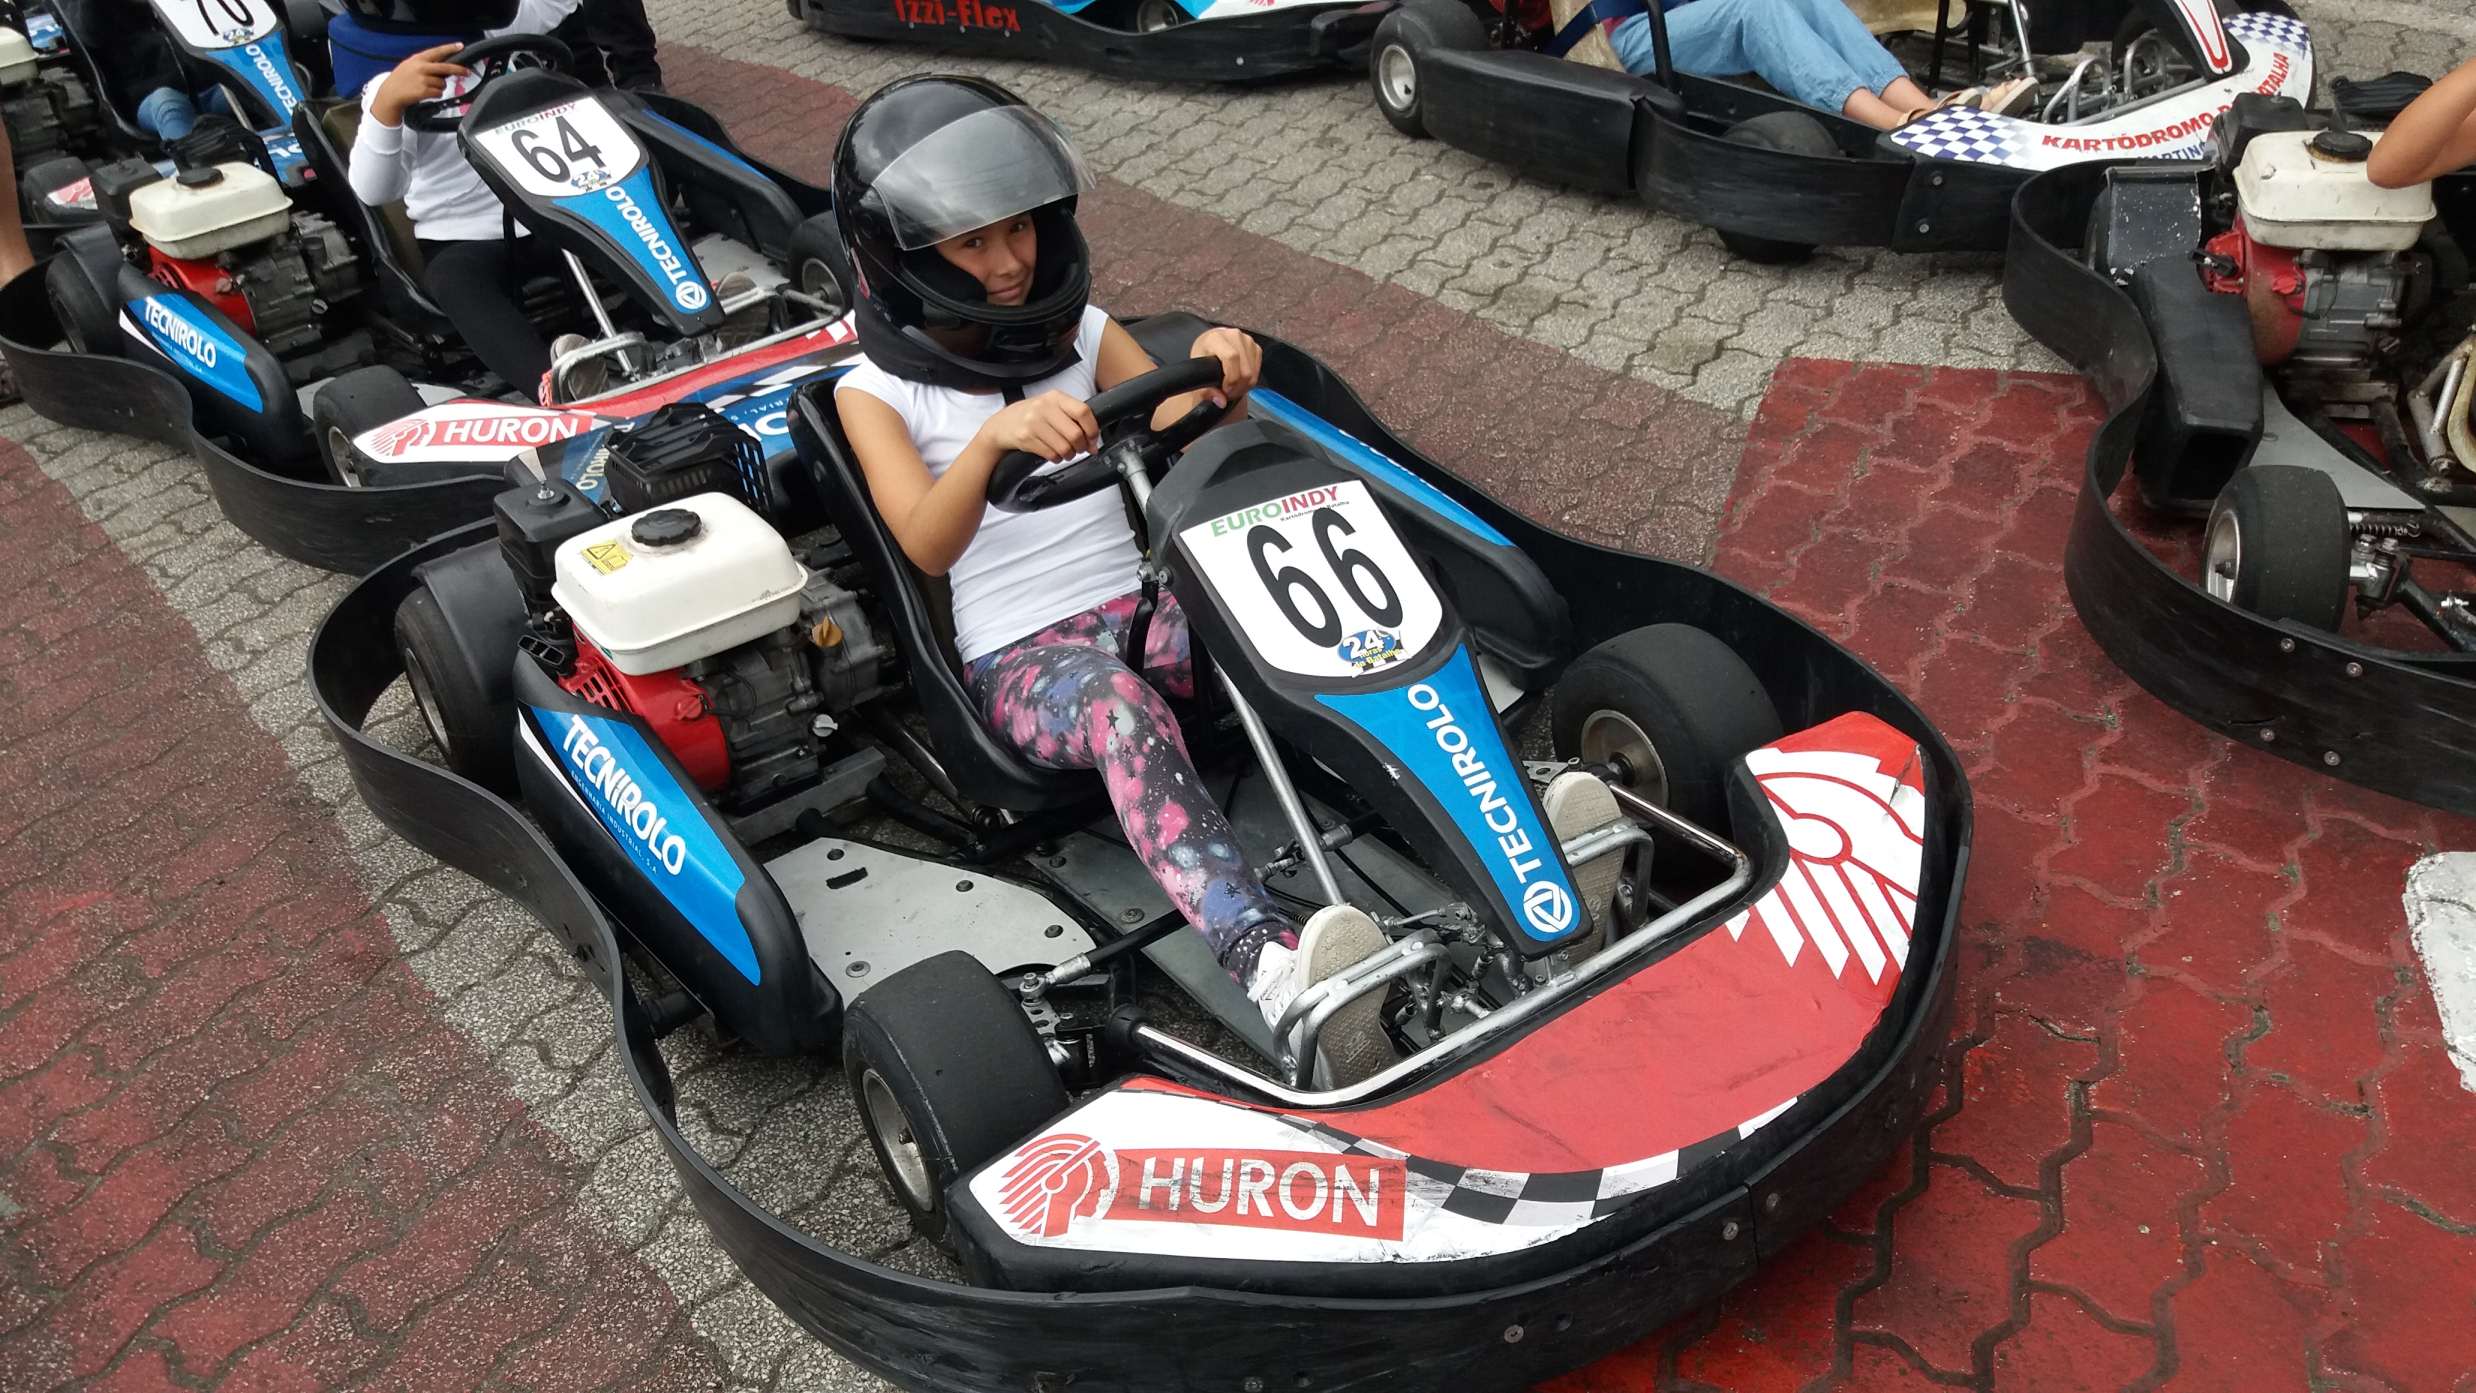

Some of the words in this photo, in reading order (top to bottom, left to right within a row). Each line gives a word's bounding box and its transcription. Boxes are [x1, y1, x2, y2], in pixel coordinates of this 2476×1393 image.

[2041, 111, 2214, 151] KARTÓDROMO
[2254, 52, 2290, 97] ATALHA
[511, 115, 606, 183] 64
[605, 186, 688, 285] TECNIROLO
[144, 295, 217, 369] TECNIROLO
[443, 417, 579, 444] HURON
[1210, 485, 1339, 537] EUROINDY
[1246, 507, 1404, 649] 66
[1343, 630, 1385, 660] 24
[562, 714, 686, 876] TECNIROLO
[1407, 683, 1542, 884] TECNIROLO
[1136, 1156, 1380, 1228] HURON
